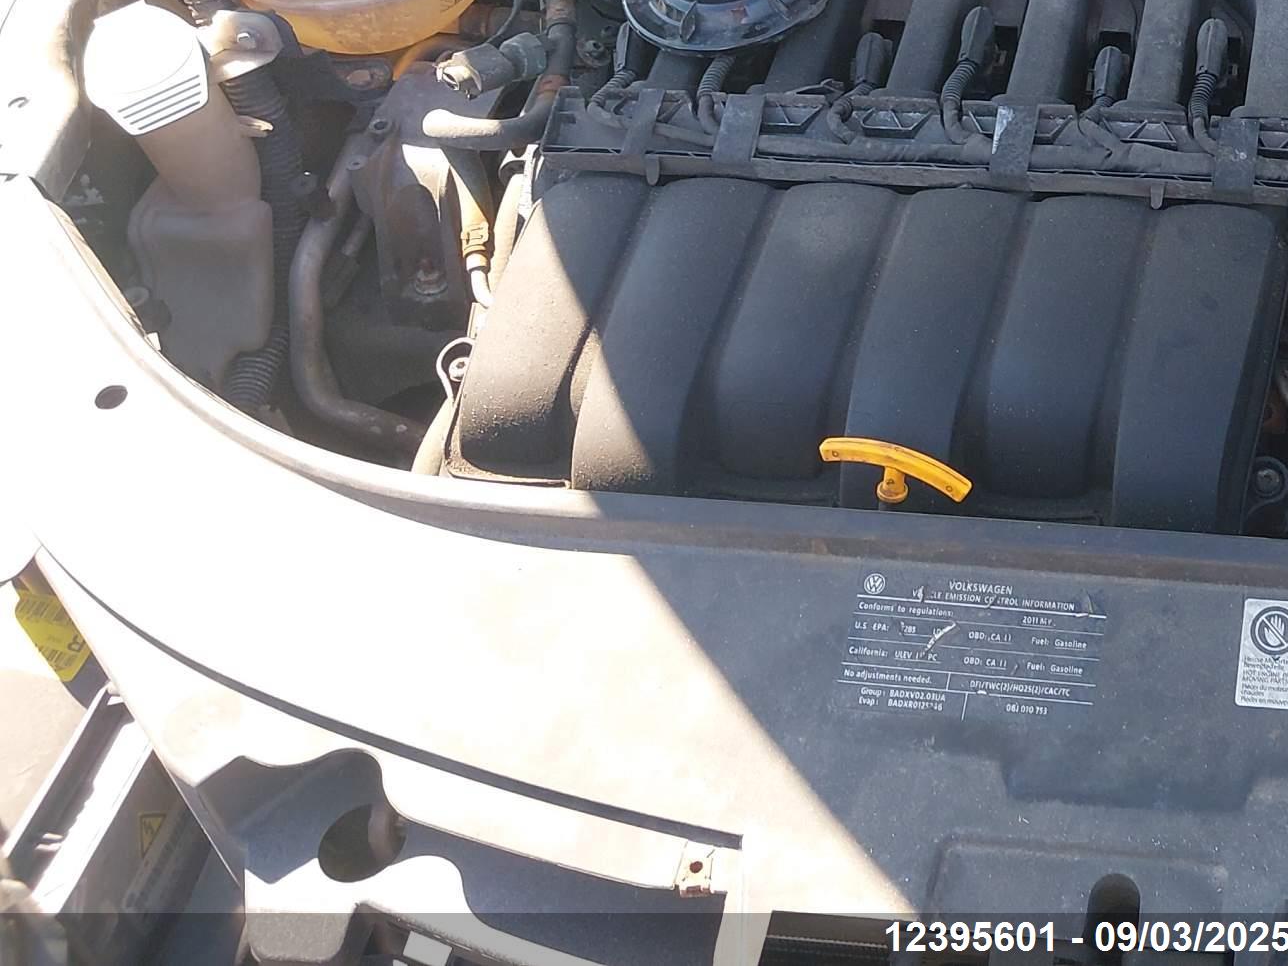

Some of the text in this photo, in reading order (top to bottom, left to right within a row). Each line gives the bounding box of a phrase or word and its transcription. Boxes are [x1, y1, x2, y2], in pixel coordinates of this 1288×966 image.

[949, 580, 1013, 595] VOLKSWAGEN
[859, 602, 894, 612] Conforms
[909, 606, 953, 617] regulations:
[945, 593, 981, 603] EMISSION
[985, 595, 1018, 606] COTROL
[1022, 600, 1075, 611] INFORMATION
[1022, 616, 1039, 625] 2011
[873, 623, 889, 631] EPA:
[991, 633, 1000, 641] CA
[1032, 637, 1049, 645] Fuel:
[1055, 639, 1087, 649] Gasoline
[849, 647, 888, 657] California:
[895, 651, 912, 659] ULEV
[964, 657, 982, 665] OBD:
[986, 658, 996, 667] CA
[1027, 662, 1046, 671] Fuel:
[1051, 664, 1083, 675] Gasoline
[844, 669, 854, 677] No
[856, 670, 901, 681] adjustments
